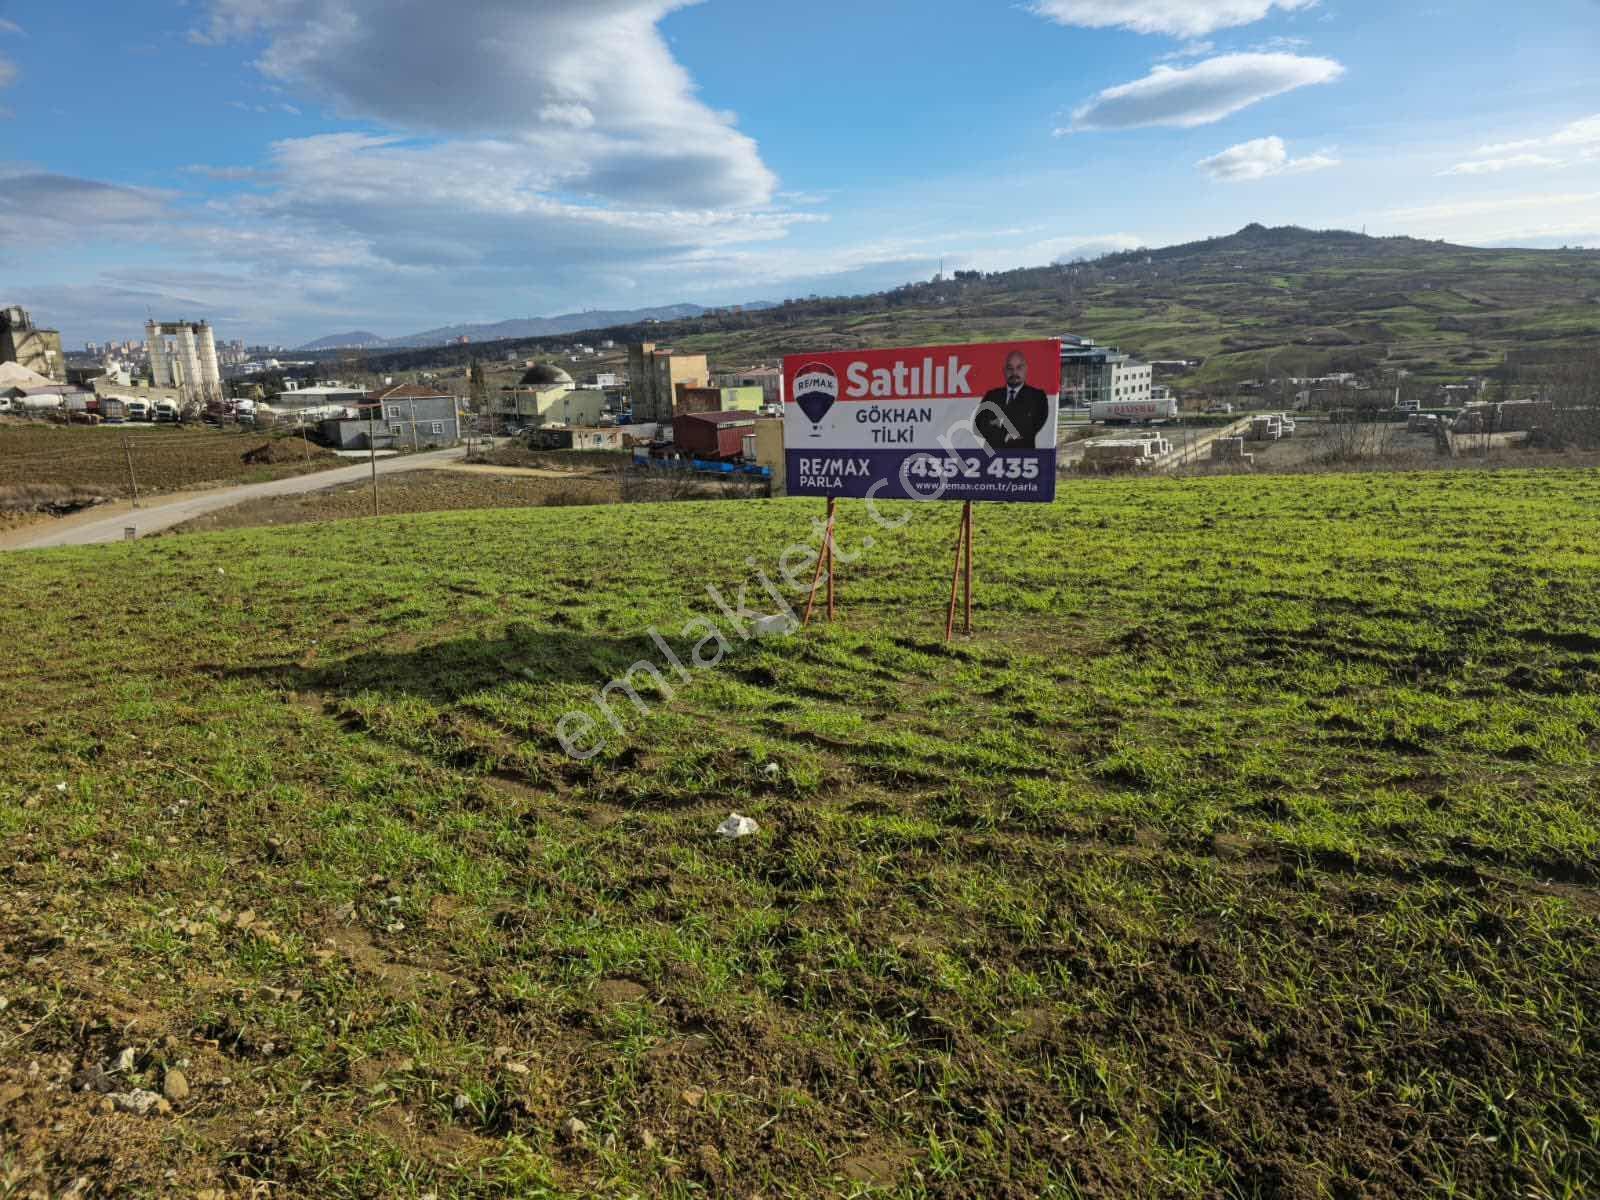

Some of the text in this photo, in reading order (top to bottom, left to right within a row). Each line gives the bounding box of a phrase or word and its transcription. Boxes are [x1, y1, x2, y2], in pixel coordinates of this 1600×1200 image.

[798, 377, 833, 390] RE/MAX
[846, 356, 972, 397] Satılık
[856, 406, 932, 424] GÖKHAN
[871, 427, 914, 443] TİLKİ
[800, 458, 870, 476] RE/MAX
[987, 458, 1039, 479] 435
[800, 476, 842, 488] PARLA
